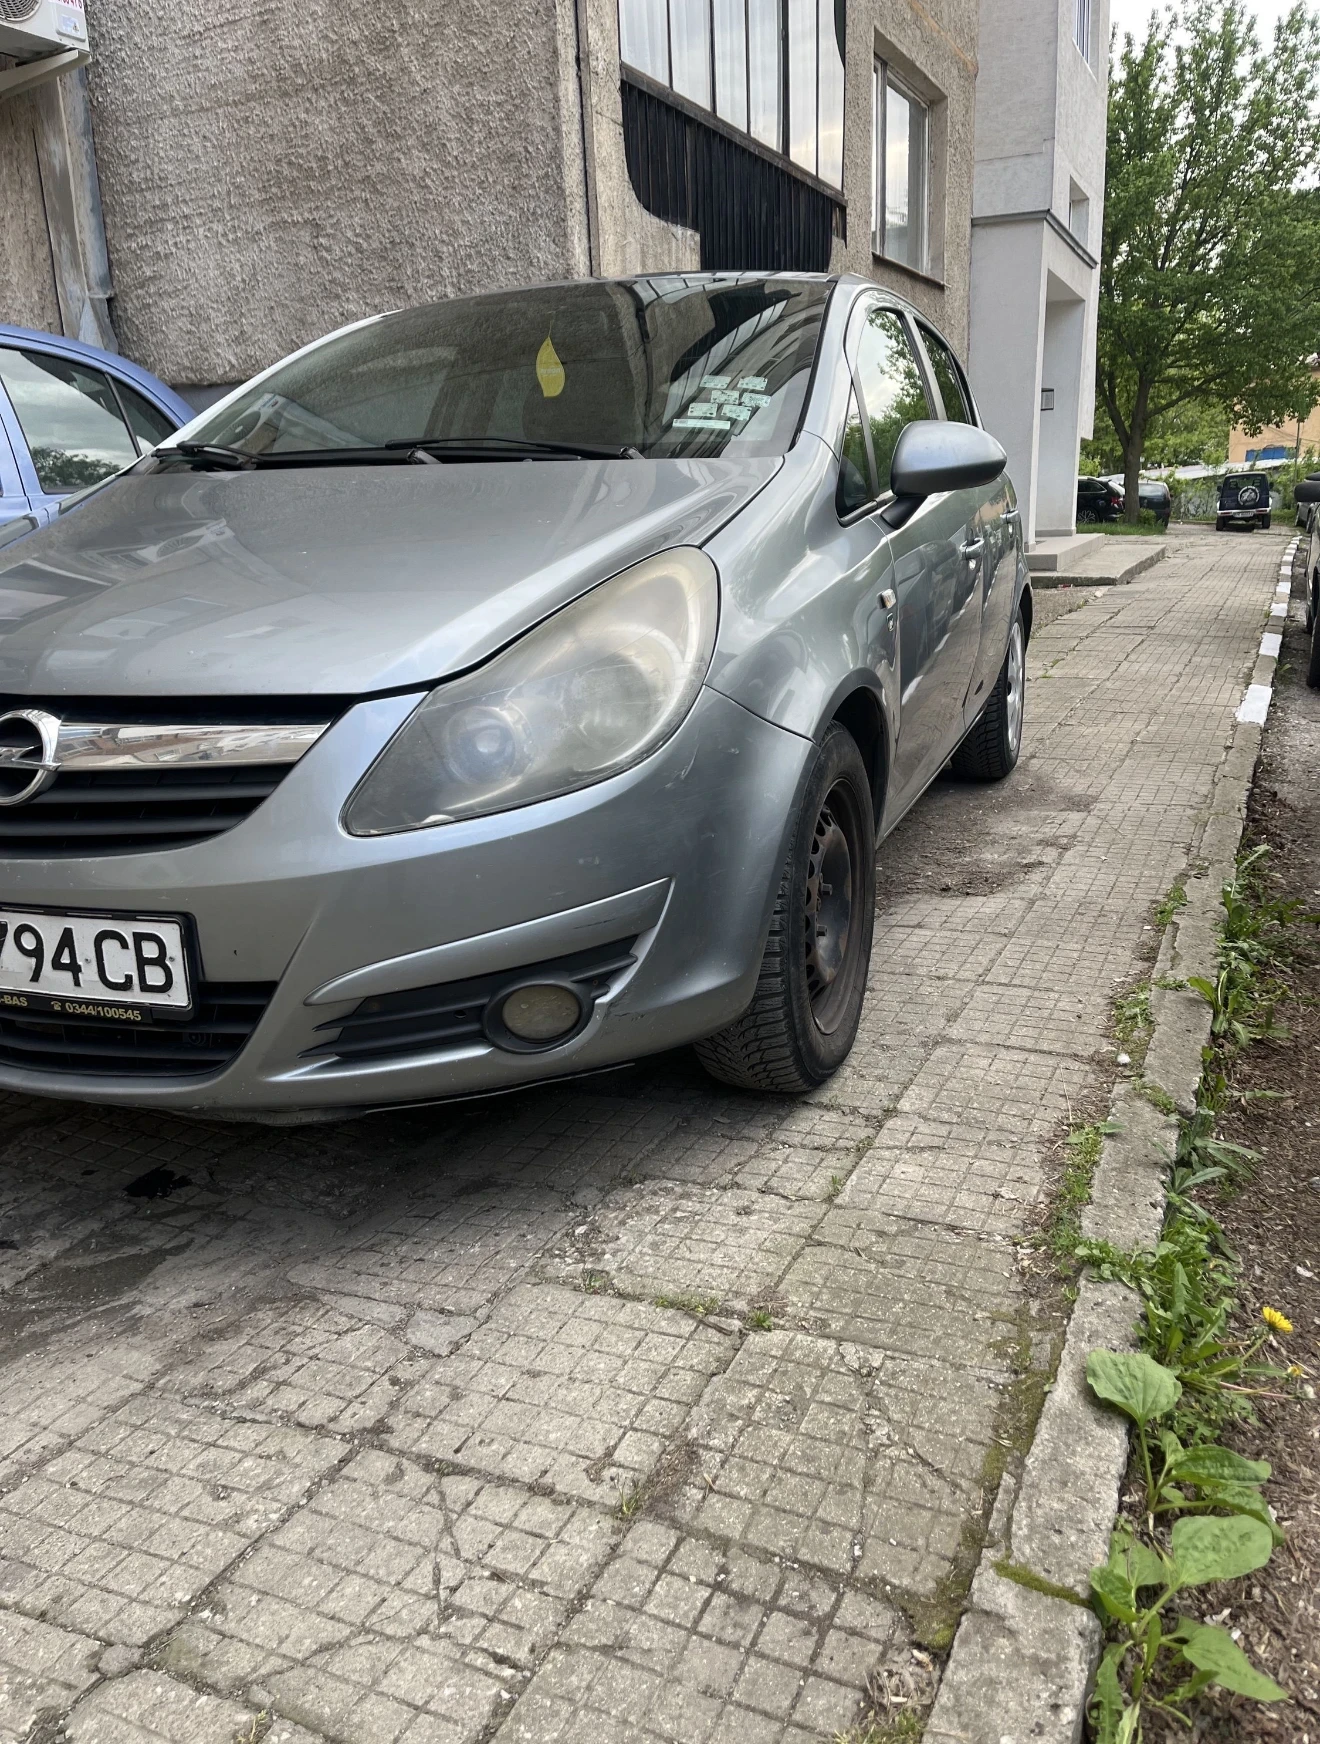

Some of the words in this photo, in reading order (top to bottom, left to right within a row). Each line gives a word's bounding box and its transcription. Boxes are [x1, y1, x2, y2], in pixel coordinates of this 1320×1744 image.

[94, 929, 174, 994] CB
[0, 995, 28, 1007] -BAS
[65, 1002, 142, 1021] 0344/100545
